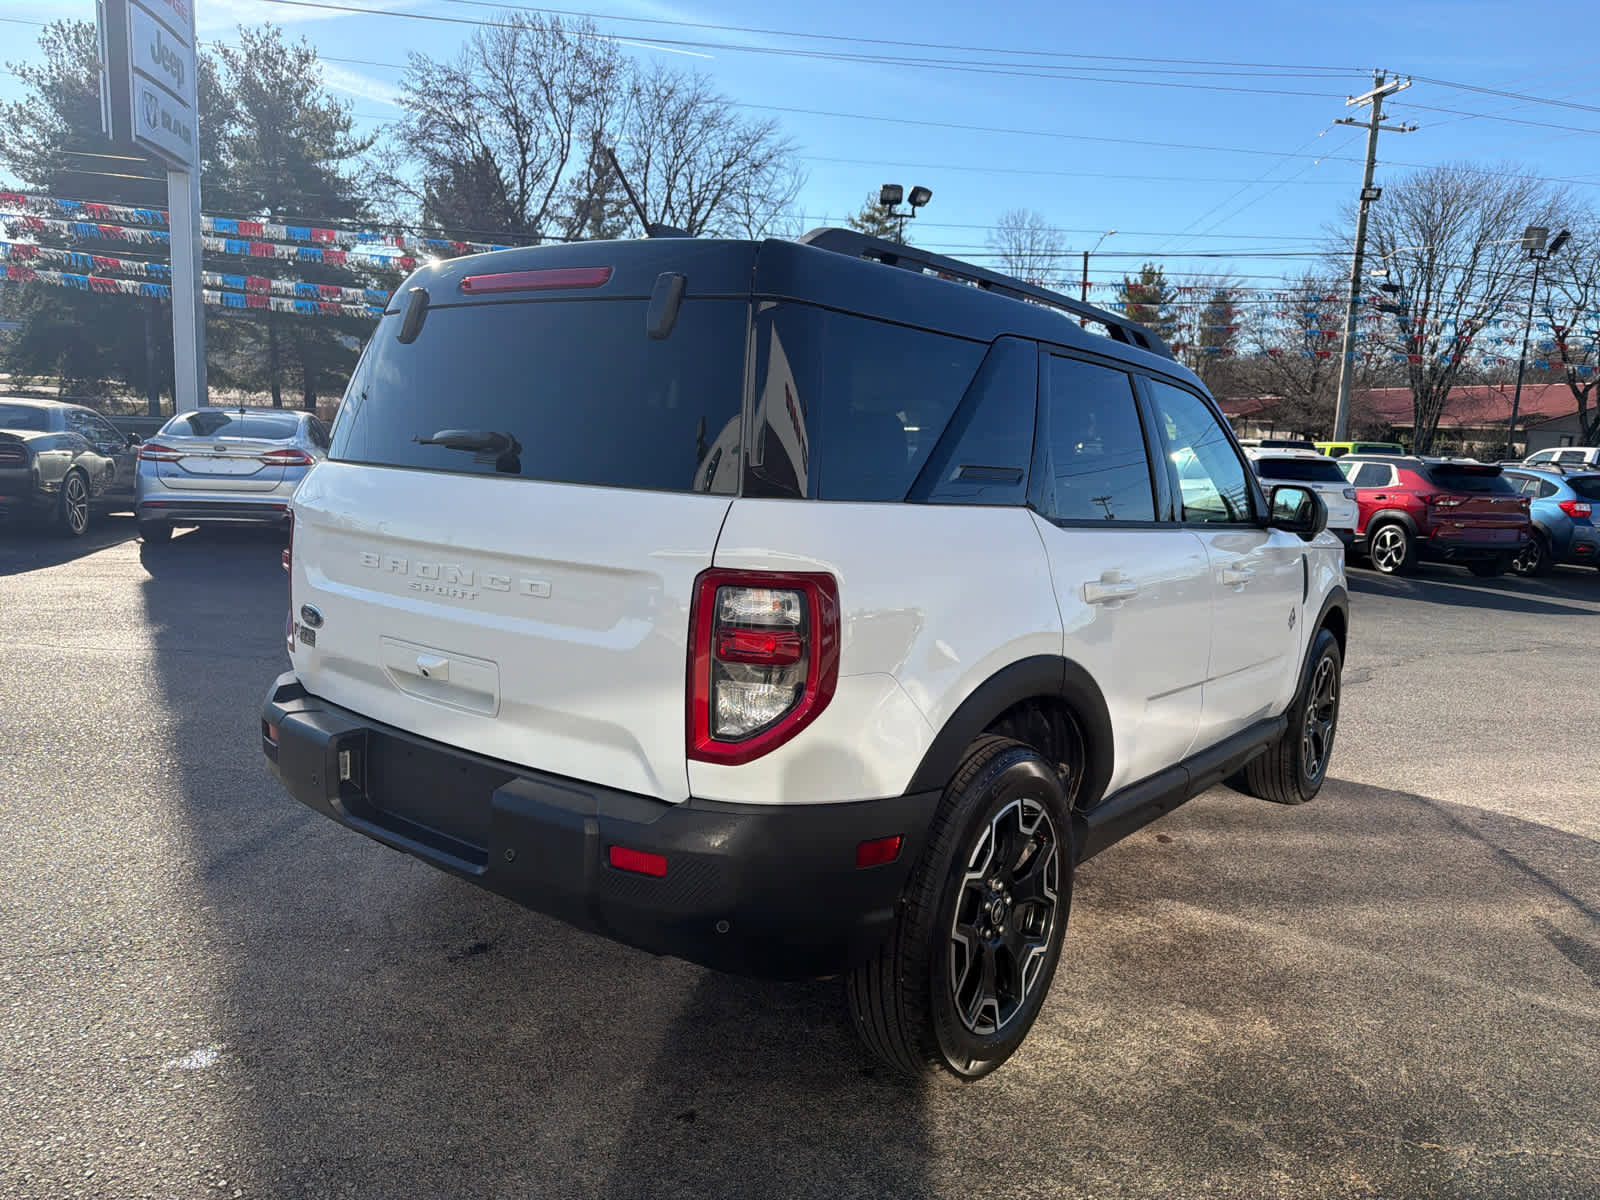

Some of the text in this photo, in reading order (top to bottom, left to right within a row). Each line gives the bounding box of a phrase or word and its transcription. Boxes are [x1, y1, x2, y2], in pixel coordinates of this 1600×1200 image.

[151, 29, 185, 89] Jeep
[359, 551, 552, 599] BRONCO
[407, 582, 479, 600] SPORT
